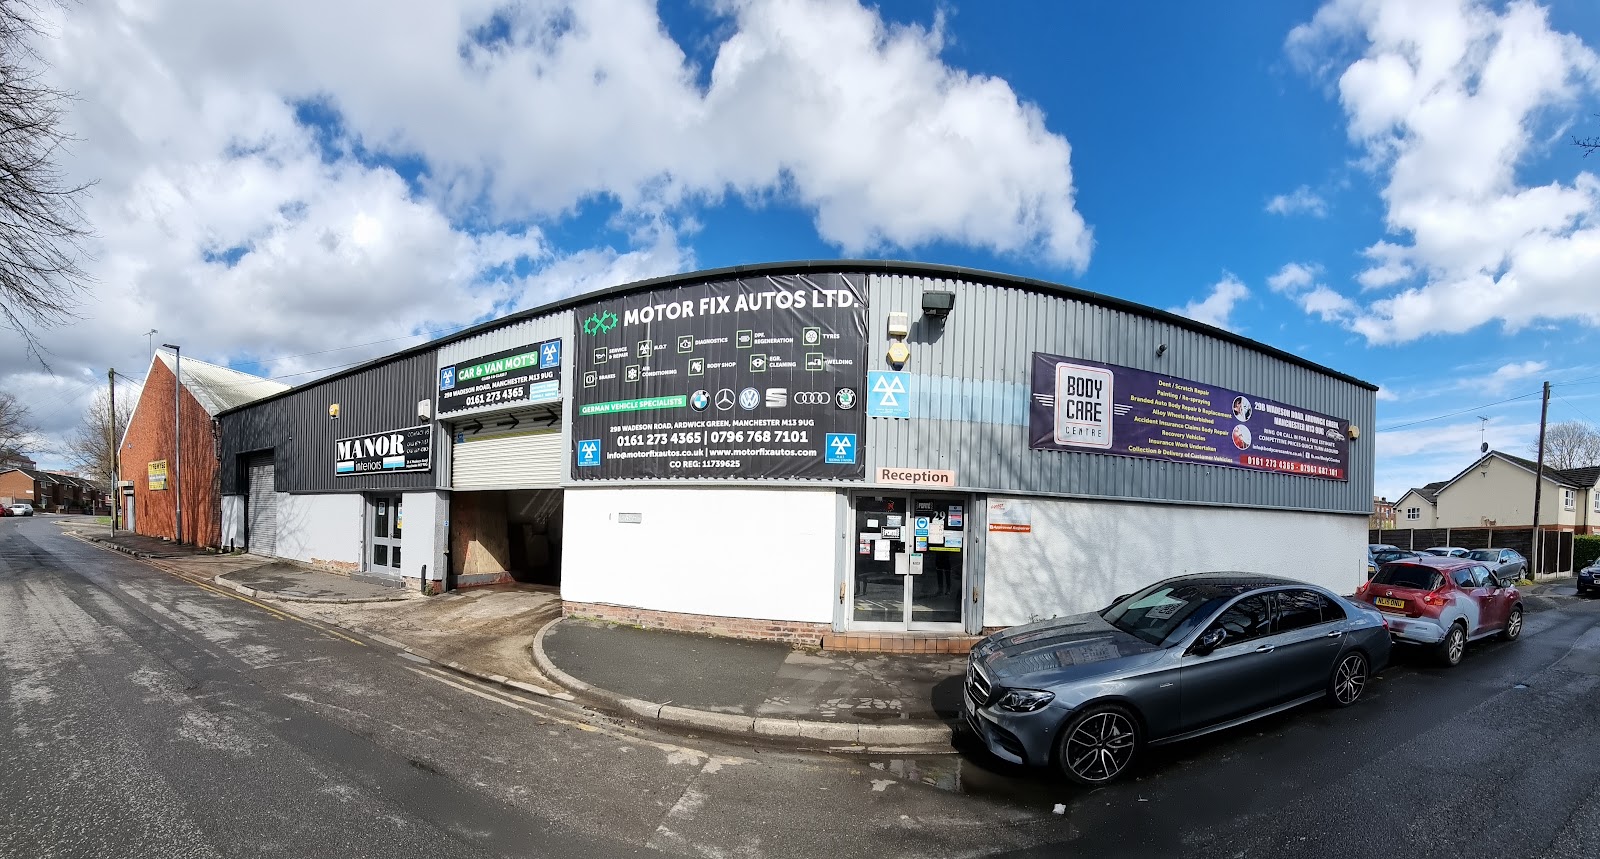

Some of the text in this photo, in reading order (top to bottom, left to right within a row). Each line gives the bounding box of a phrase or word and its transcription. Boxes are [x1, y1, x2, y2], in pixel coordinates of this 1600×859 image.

[623, 290, 859, 327] MOTOR FIX AUTOS LTD.
[695, 337, 728, 346] DIAGNOSTICS
[458, 368, 475, 380] CAR
[476, 367, 482, 376] &
[484, 362, 503, 374] VAN
[505, 354, 535, 368] MOT'S
[453, 387, 475, 398] WADESON
[492, 375, 527, 388] MANCHESTER
[529, 373, 540, 381] M13
[1068, 376, 1102, 399] BODY
[1175, 384, 1193, 392] Scratch
[1194, 388, 1209, 396] Repair
[466, 395, 485, 406] 0161
[486, 392, 500, 403] 273
[502, 387, 524, 399] 4365
[1157, 390, 1178, 399] Painting
[1182, 395, 1210, 406] Re-spraying
[582, 398, 682, 413] GERMAN VEHICLE SPECIALISTS
[1066, 400, 1102, 422] CARE
[1130, 395, 1154, 404] Branded
[1202, 408, 1232, 419] Replacement
[1254, 402, 1266, 411] 29B
[1266, 404, 1290, 417] WADESON
[1167, 411, 1185, 419] Wheels
[1186, 414, 1214, 424] Refurbished
[622, 423, 652, 431] WADESON
[1066, 426, 1101, 437] CENTRE
[1134, 416, 1158, 425] Accident
[1159, 420, 1184, 429] Insurance
[1201, 426, 1213, 434] Body
[1274, 417, 1305, 431] MANCHESTER
[1306, 424, 1314, 433] M13
[617, 430, 808, 446] 0161 273 4365 0796 768 7101
[1162, 430, 1206, 441] Recovery Vehicles
[1259, 435, 1287, 445] COMPETITIVE
[337, 434, 405, 460] MANOR
[1128, 445, 1157, 454] Collection
[1162, 449, 1184, 458] Delivery
[1148, 438, 1174, 446] Insurance
[1189, 443, 1216, 452] Undertaken
[607, 448, 817, 459] info@motorfixautos.co.uk www.motorfixautos.com
[356, 460, 382, 471] interiors
[1248, 456, 1263, 466] 0161
[1266, 459, 1277, 468] 273
[1279, 460, 1294, 470] 4365
[882, 469, 948, 483] Reception
[933, 510, 946, 520] 29
